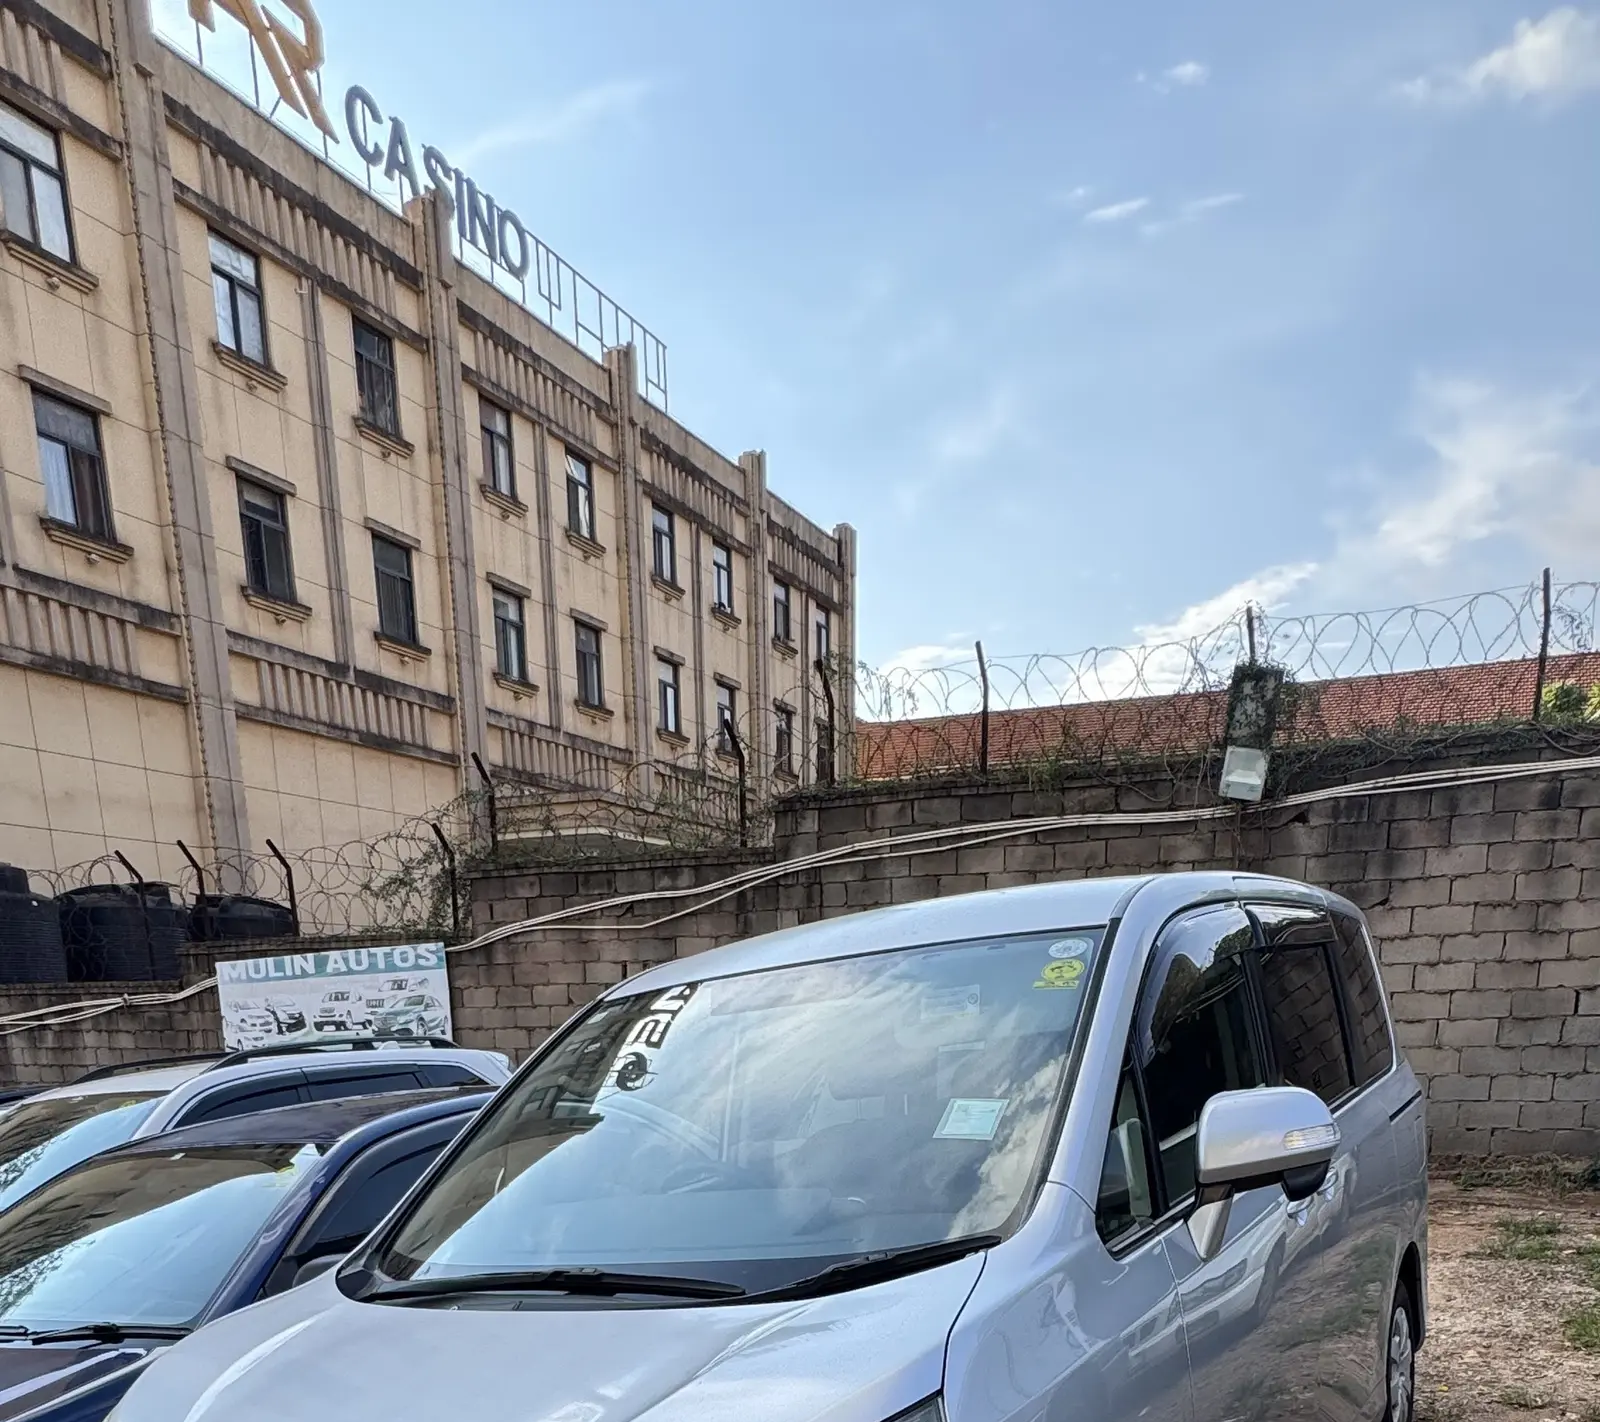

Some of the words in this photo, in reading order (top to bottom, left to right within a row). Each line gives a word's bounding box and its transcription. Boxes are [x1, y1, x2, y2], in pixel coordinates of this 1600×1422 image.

[345, 84, 530, 282] CASINO
[221, 954, 317, 982] MULIN
[325, 943, 438, 973] AUTOS
